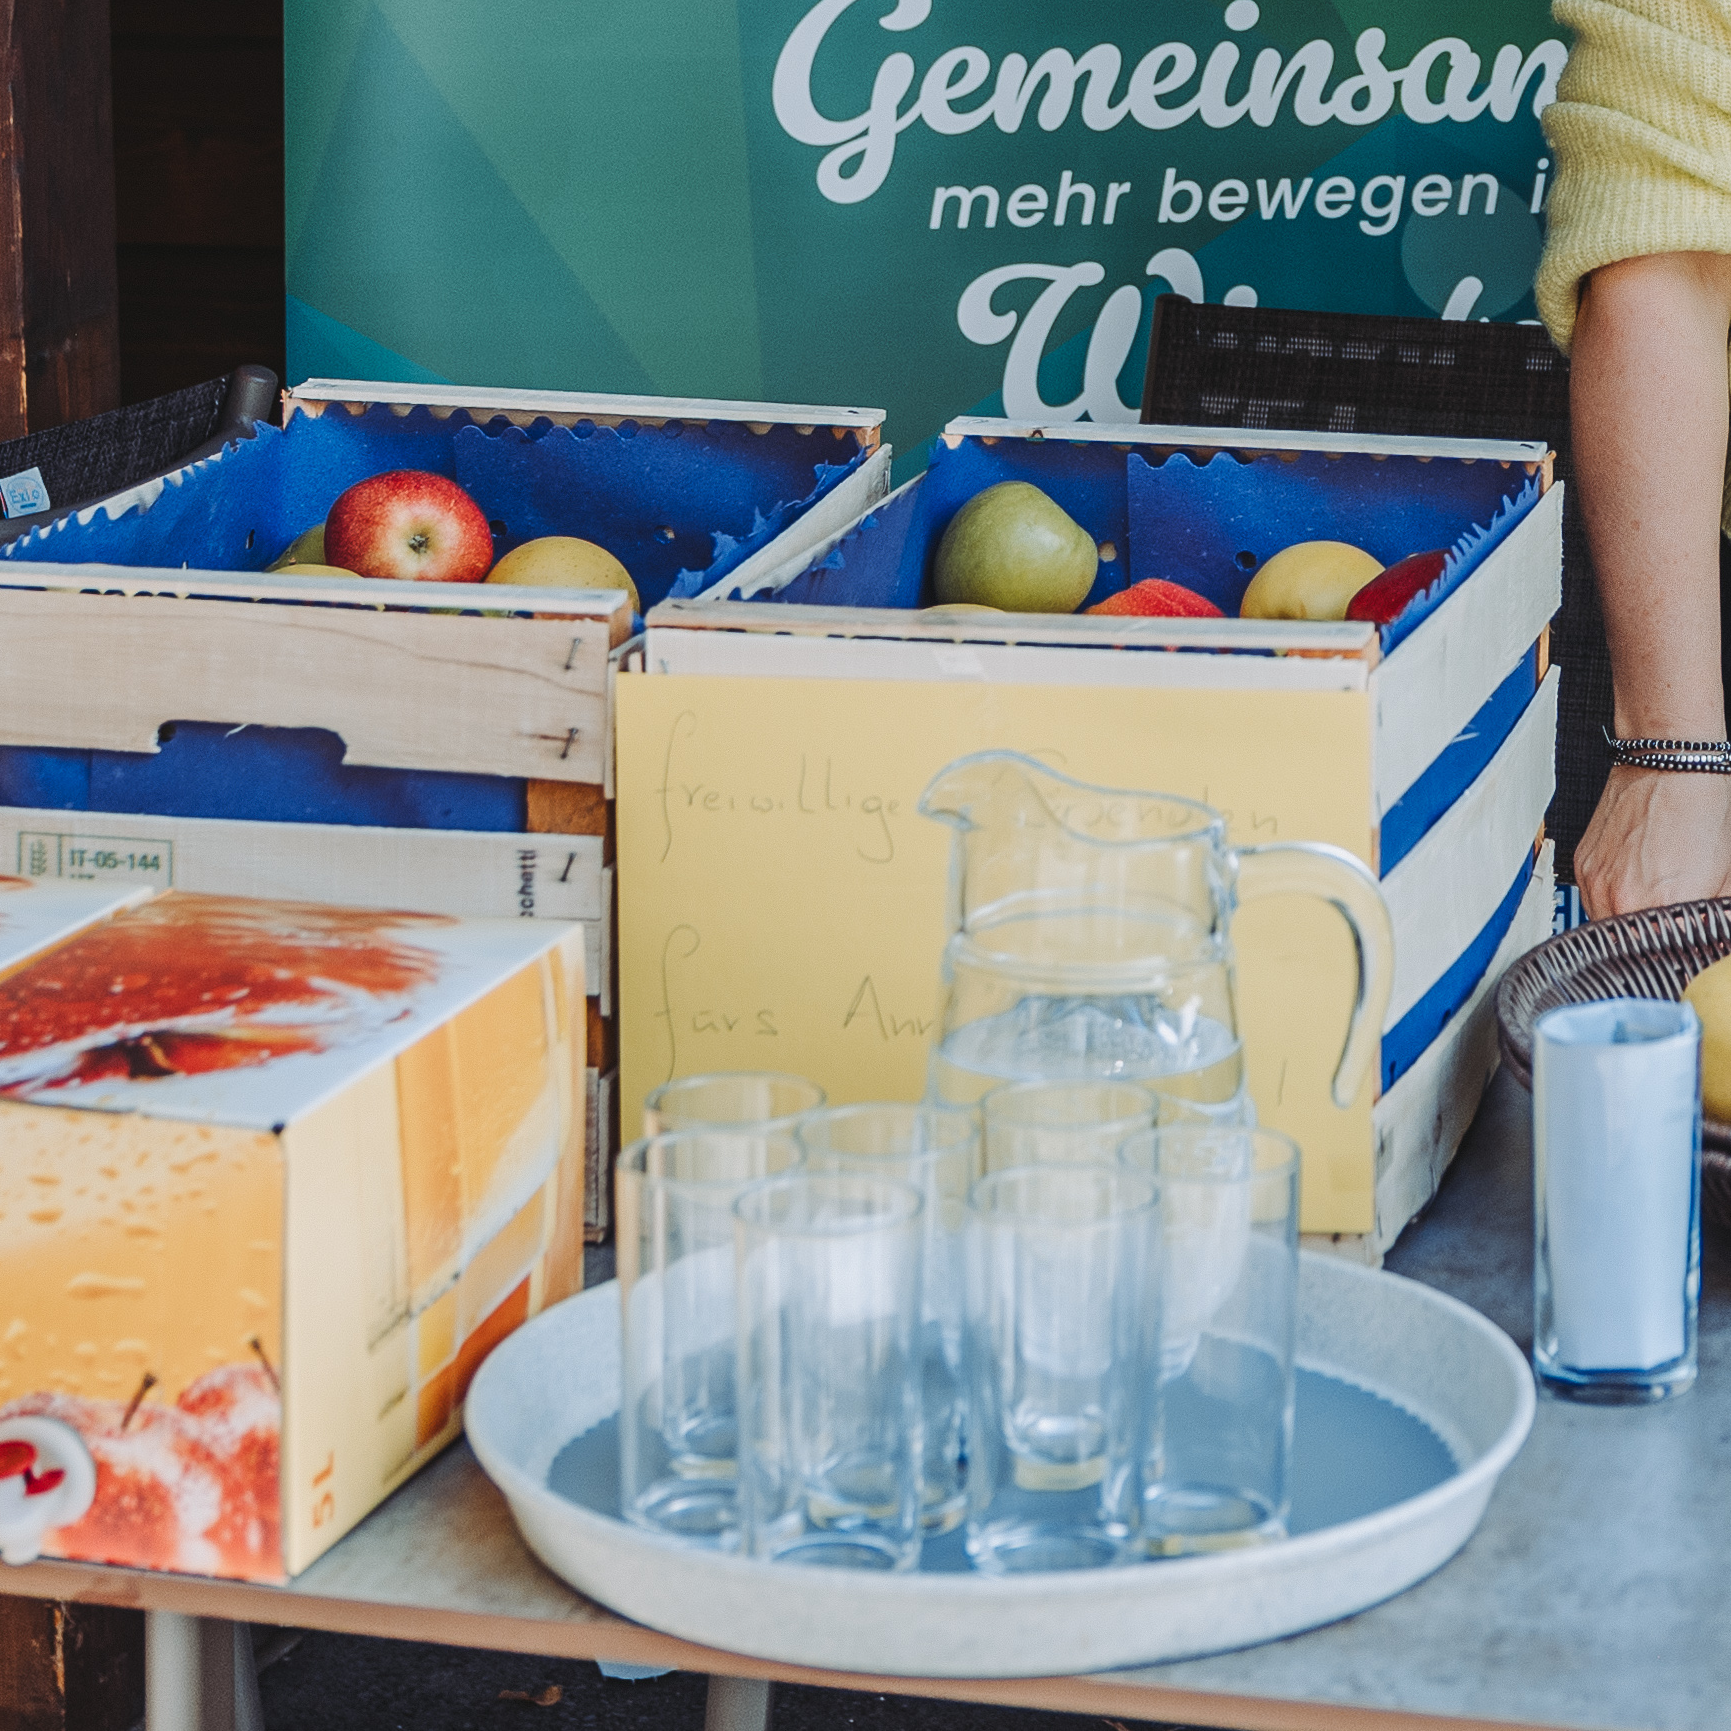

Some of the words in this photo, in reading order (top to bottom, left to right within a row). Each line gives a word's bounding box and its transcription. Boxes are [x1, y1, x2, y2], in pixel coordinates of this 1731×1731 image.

[929, 171, 1130, 230] mehr
[1158, 166, 1500, 236] bewegen
[1529, 158, 1550, 215] i
[70, 849, 160, 871] IT-05-144
